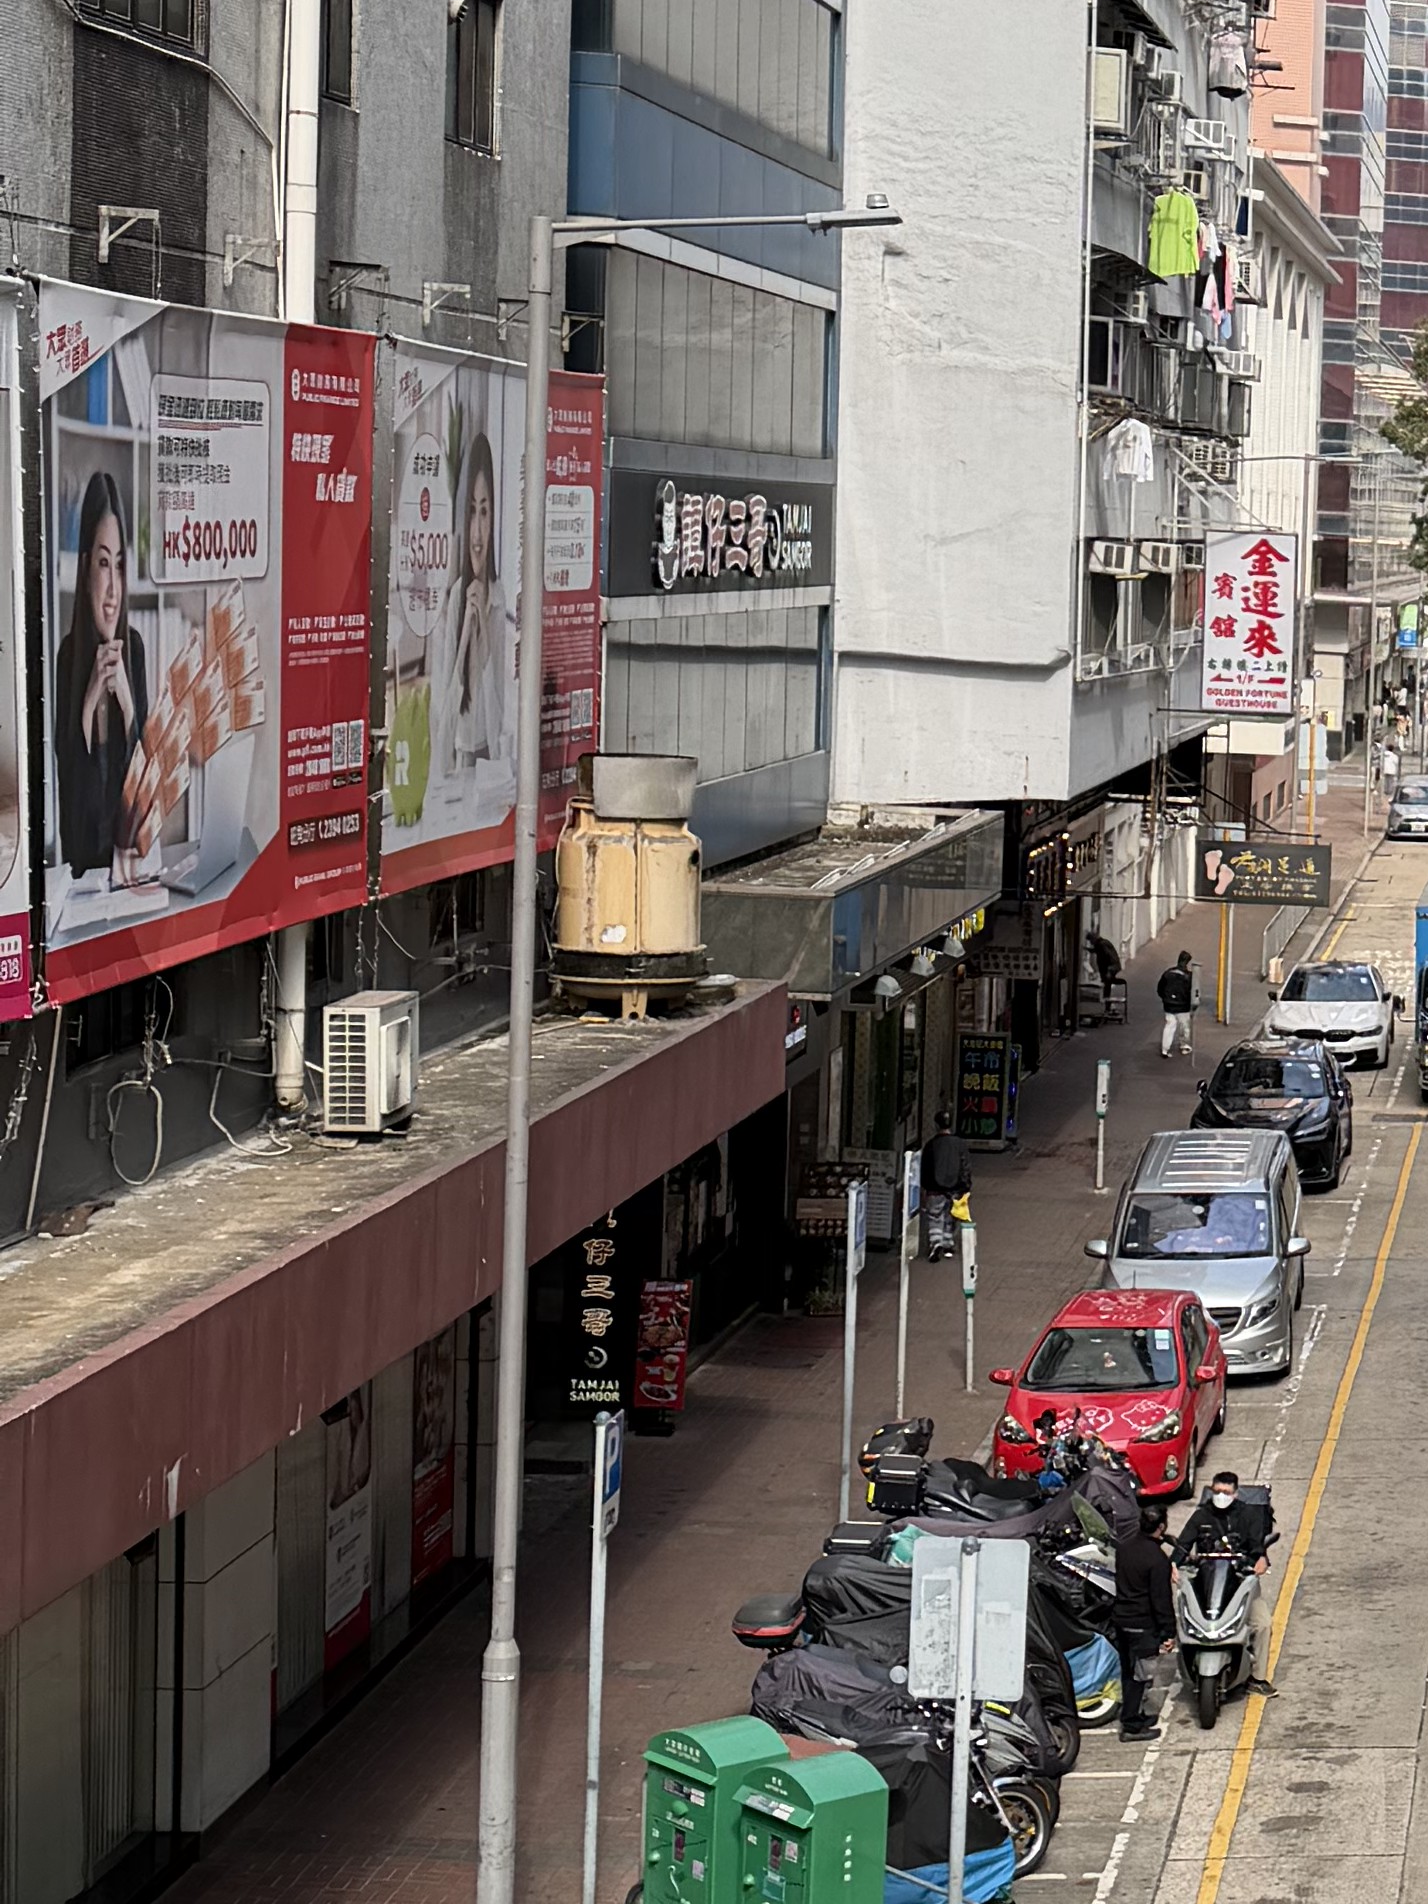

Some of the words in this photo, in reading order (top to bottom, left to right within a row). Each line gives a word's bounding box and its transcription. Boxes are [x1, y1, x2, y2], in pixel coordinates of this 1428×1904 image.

[163, 516, 257, 569] HK$800,000
[1240, 538, 1290, 659] 金運來
[1206, 687, 1243, 698] GOLDEN
[1245, 688, 1288, 700] FORTUNE
[1215, 698, 1278, 709] GUESTHOUSE
[581, 1208, 617, 1336] 仔三哥
[569, 1391, 620, 1402] SAMGOR
[570, 1378, 620, 1390] TAMJAI
[604, 1424, 619, 1497] P
